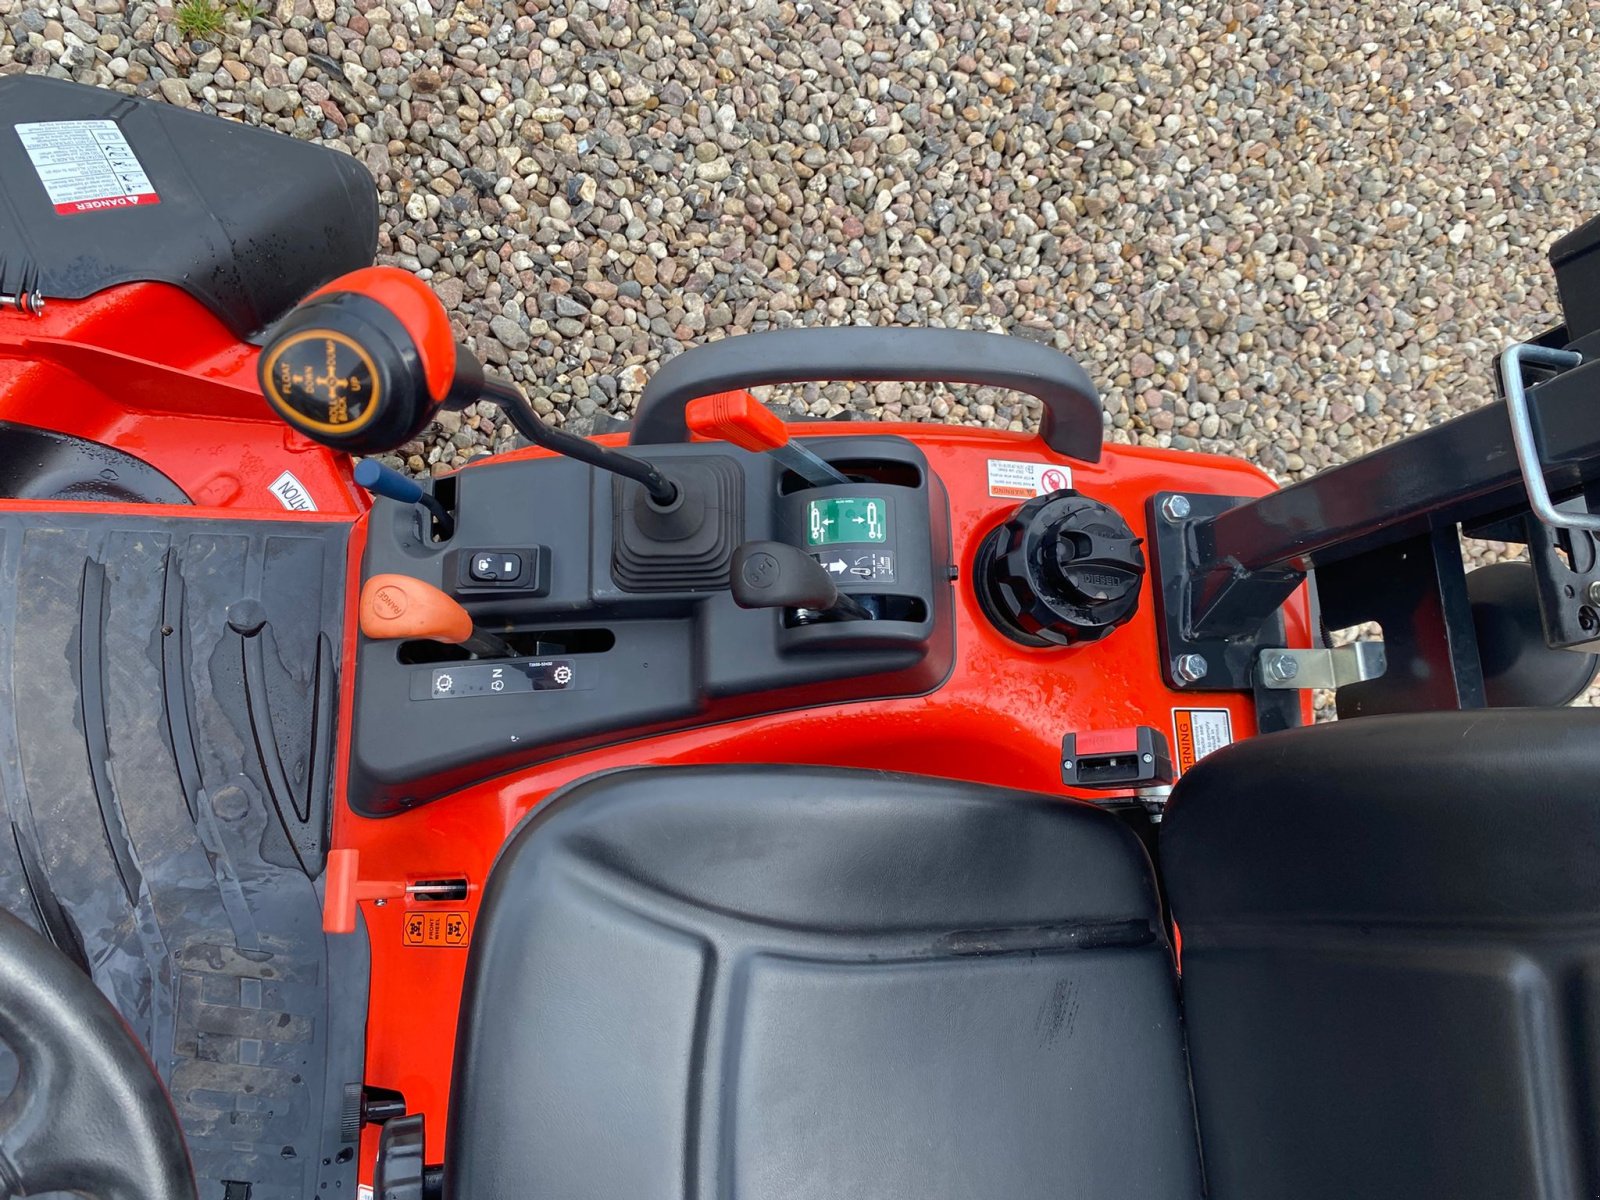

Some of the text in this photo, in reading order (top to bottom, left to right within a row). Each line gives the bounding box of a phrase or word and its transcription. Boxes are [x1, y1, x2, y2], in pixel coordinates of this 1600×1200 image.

[76, 199, 127, 211] DANGER
[281, 362, 292, 394] FLOAT
[304, 366, 315, 394] DOWN
[350, 376, 361, 392] UP
[278, 481, 309, 511] ATION
[1084, 574, 1120, 587] DIESEL
[377, 591, 402, 615] RANGE
[492, 668, 503, 678] N
[1180, 723, 1193, 771] ARNING
